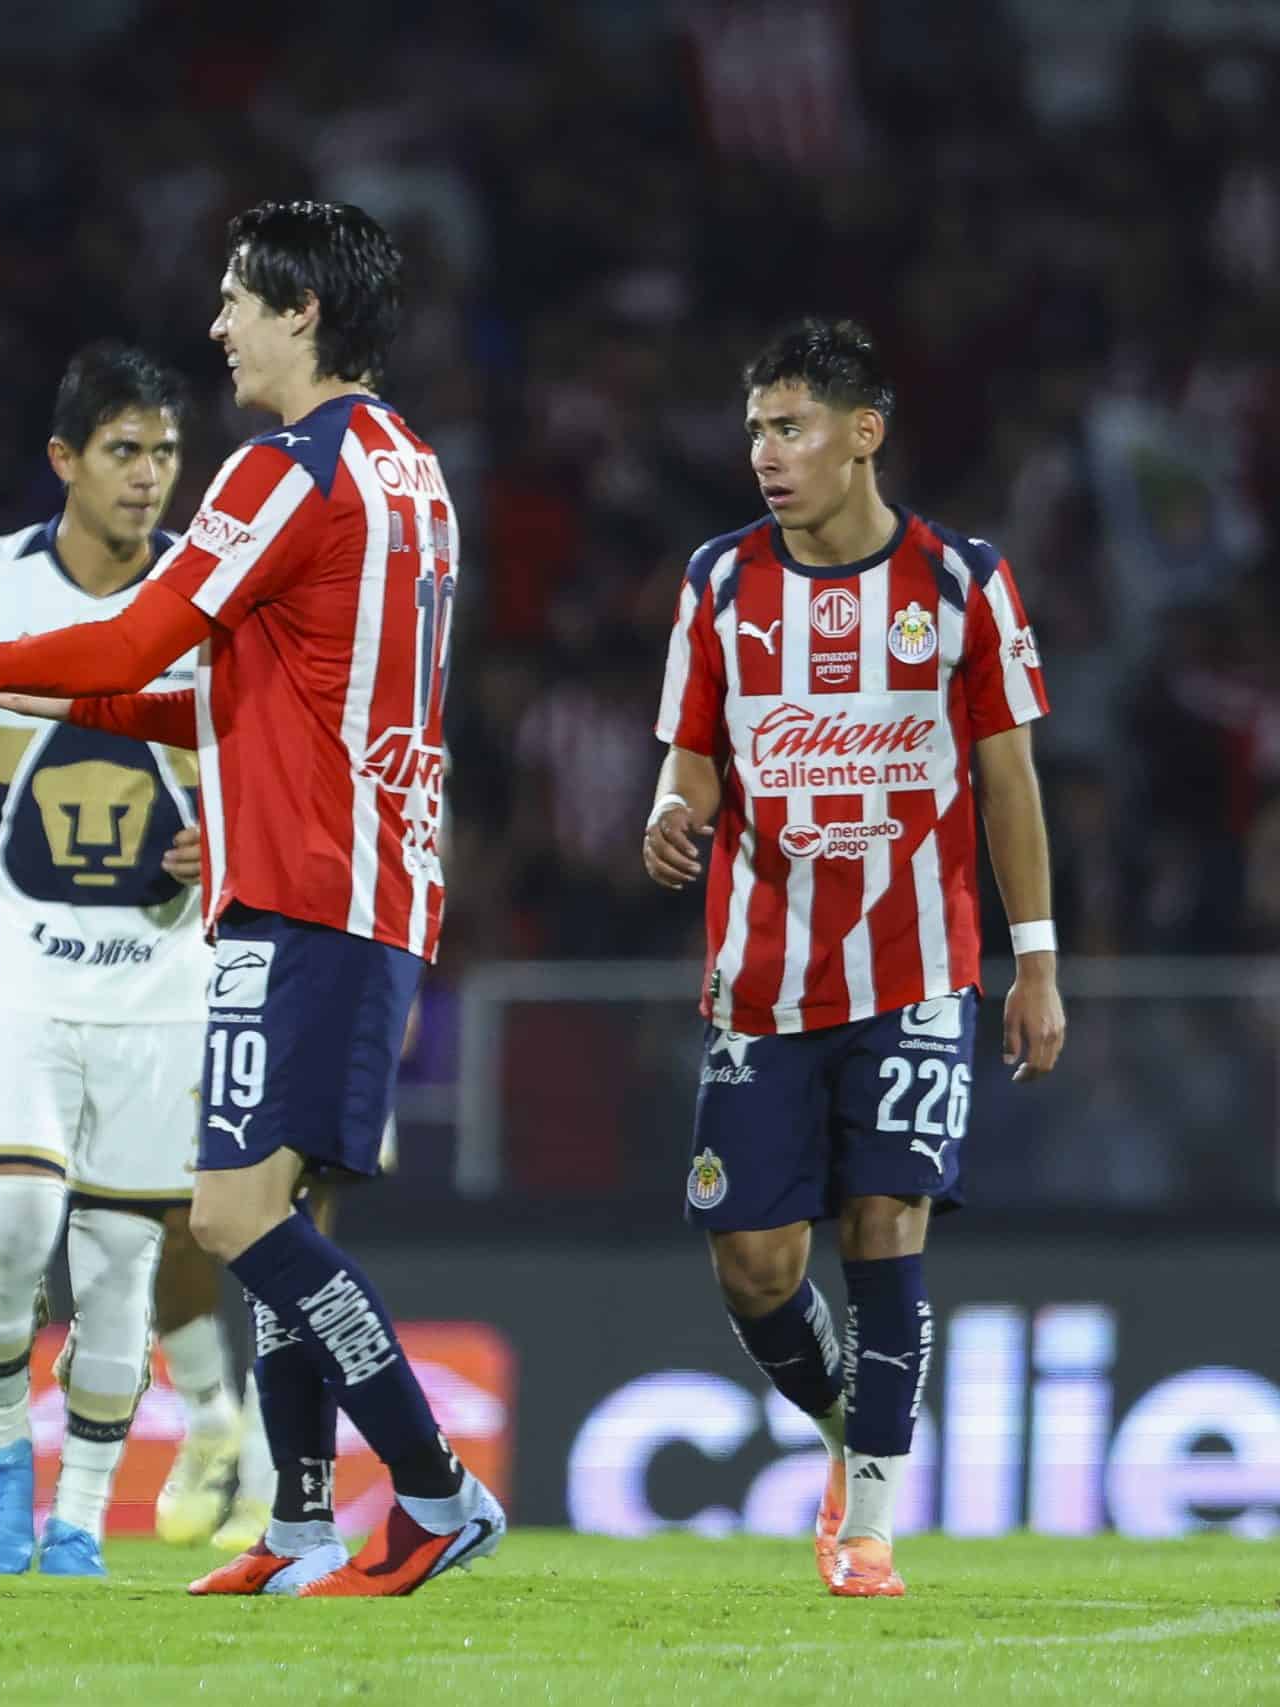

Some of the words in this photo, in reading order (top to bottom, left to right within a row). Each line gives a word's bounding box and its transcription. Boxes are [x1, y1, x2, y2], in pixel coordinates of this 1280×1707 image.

[811, 651, 858, 662] amazon
[815, 663, 853, 677] prime
[747, 702, 936, 768] Caliente
[760, 761, 929, 789] caliente.mx
[827, 821, 899, 839] mercado
[827, 840, 869, 856] pago
[209, 1029, 268, 1109] 19
[875, 1056, 973, 1139] 226
